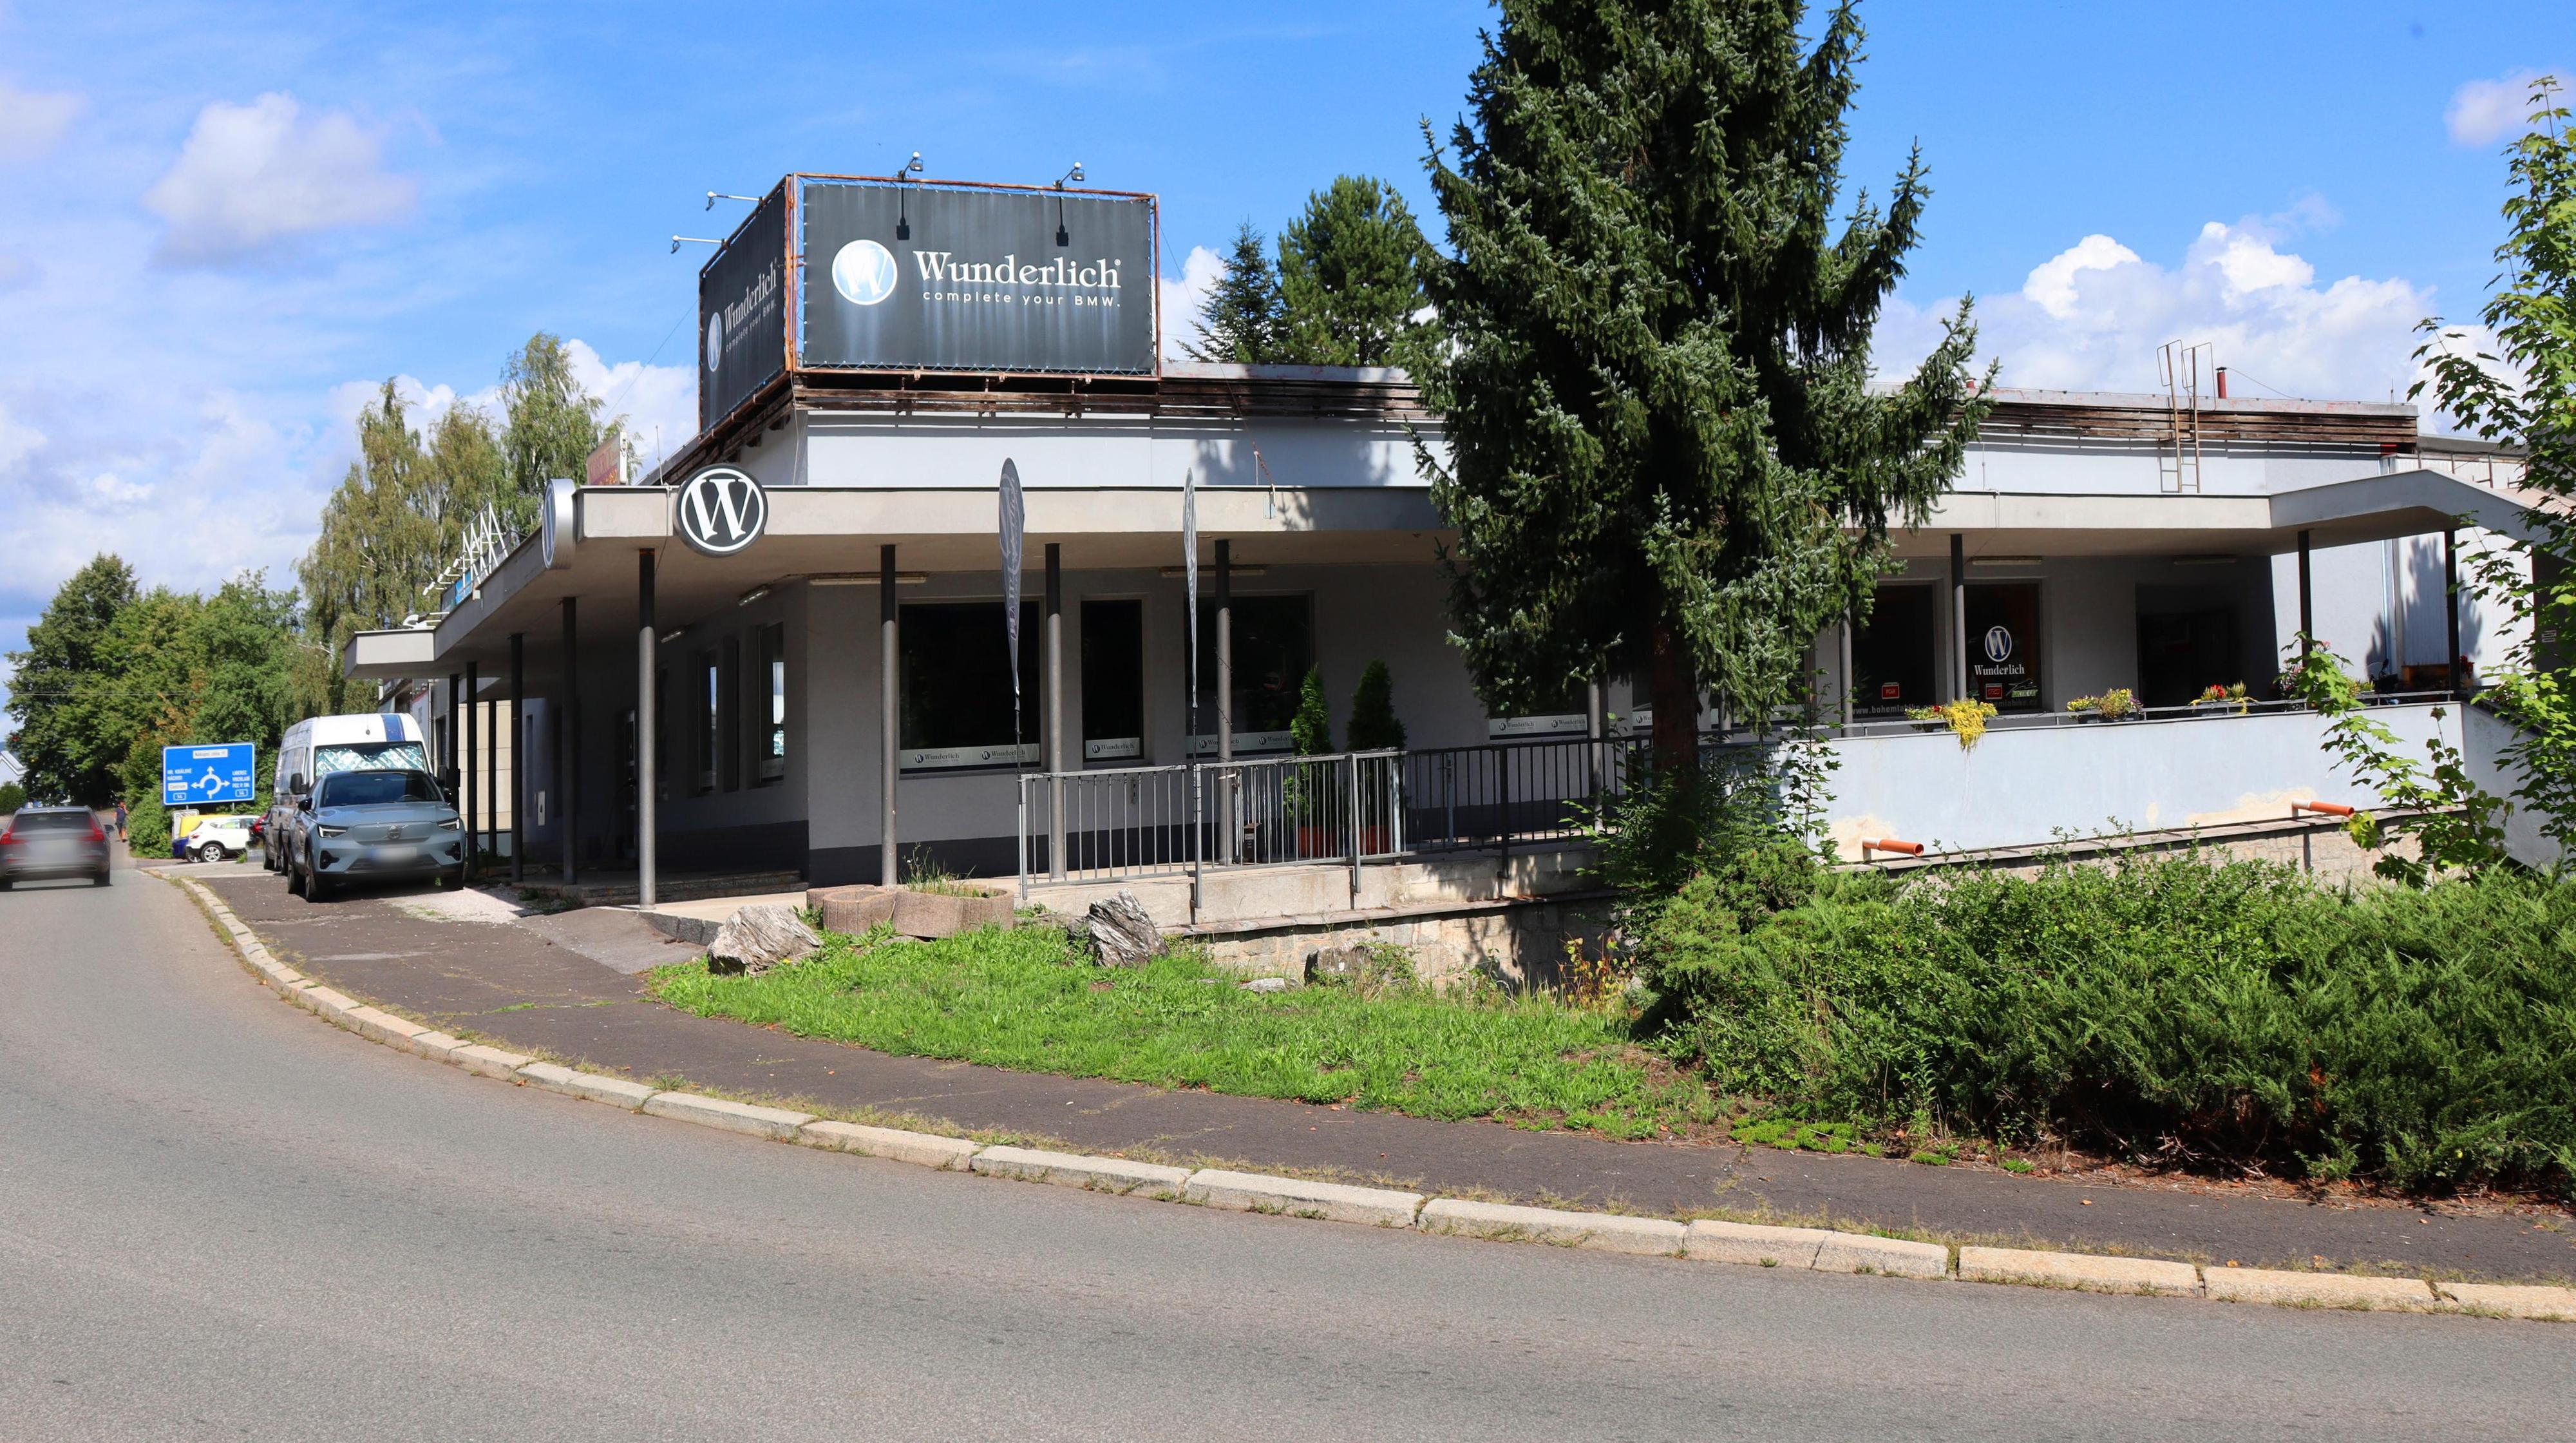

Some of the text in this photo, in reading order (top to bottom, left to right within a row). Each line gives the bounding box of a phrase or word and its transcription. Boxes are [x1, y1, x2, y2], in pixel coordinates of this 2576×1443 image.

[923, 291, 1121, 307] complete your BMW.
[1974, 664, 2025, 676] Wunderlich
